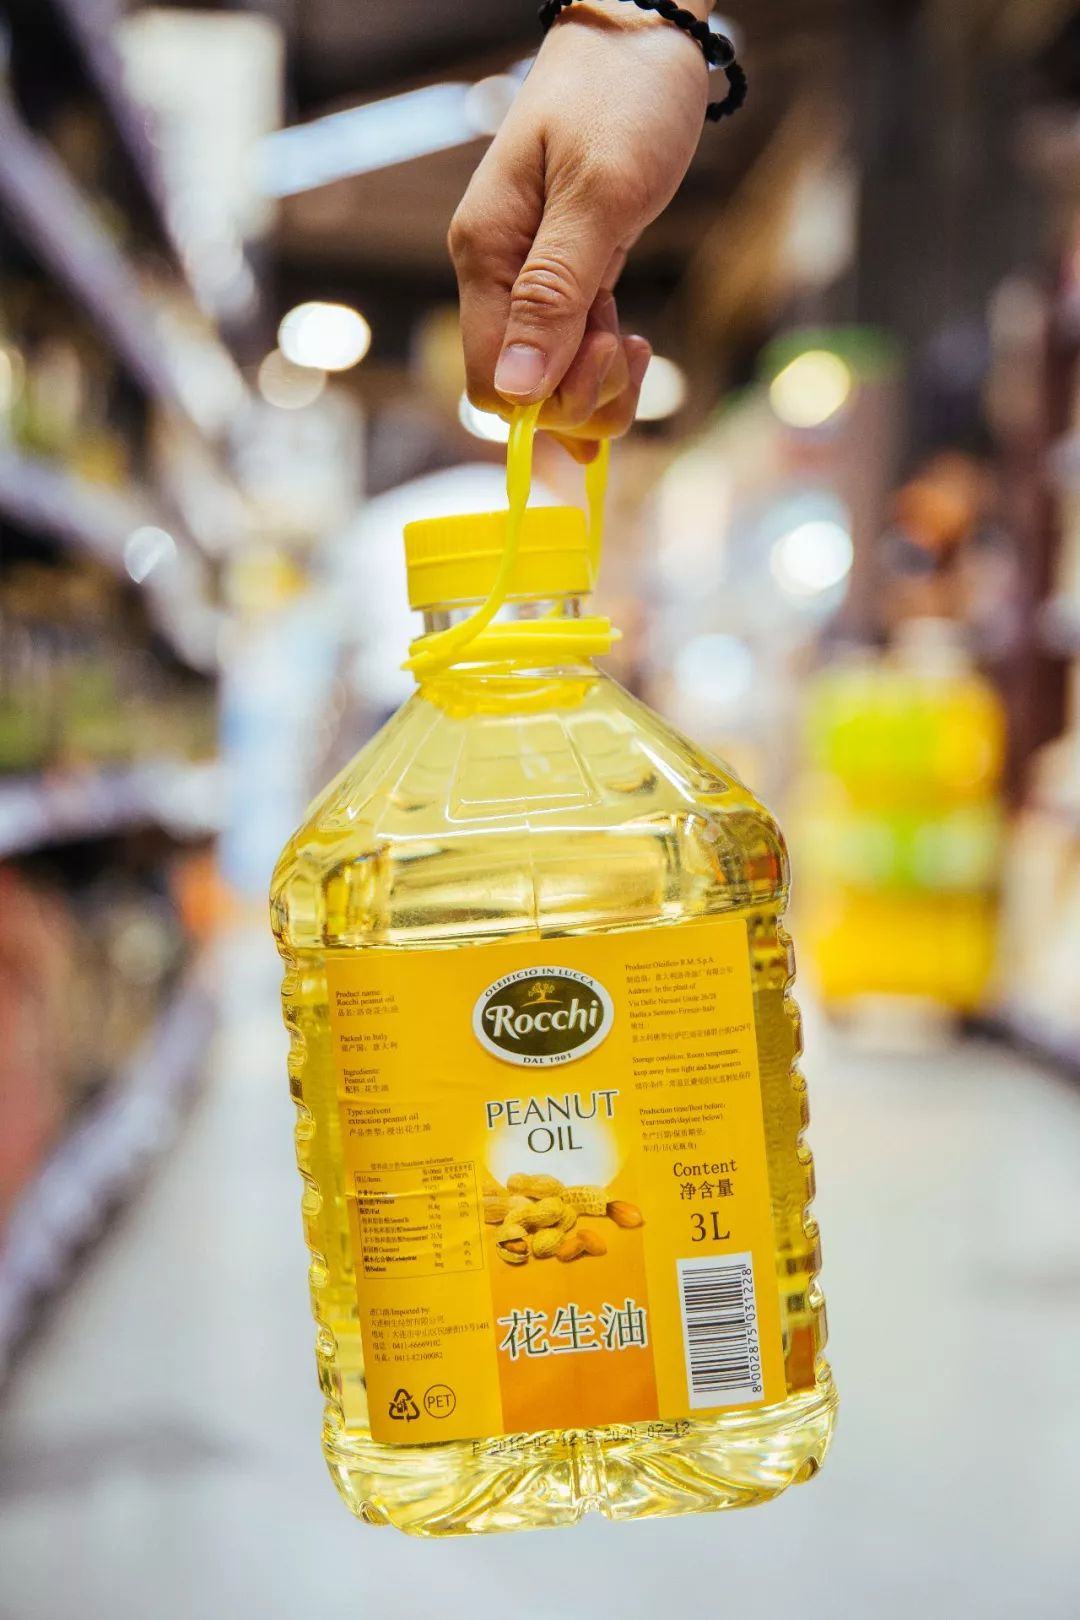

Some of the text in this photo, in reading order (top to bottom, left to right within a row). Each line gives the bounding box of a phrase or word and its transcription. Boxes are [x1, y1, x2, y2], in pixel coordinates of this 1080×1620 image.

[485, 968, 538, 997] OLEIFICIO
[558, 968, 594, 987] LUCCA
[485, 998, 599, 1040] Rocchi
[340, 1034, 362, 1042] Packed
[523, 1056, 544, 1064] DAL
[383, 1115, 407, 1124] peanut
[486, 1091, 618, 1128] PEANUT
[527, 1125, 583, 1154] OIL
[673, 1159, 738, 1177] Content
[679, 1178, 734, 1200] 净含量
[690, 1210, 731, 1242] 3L
[498, 1299, 647, 1359] 花生油
[427, 1394, 452, 1409] PET
